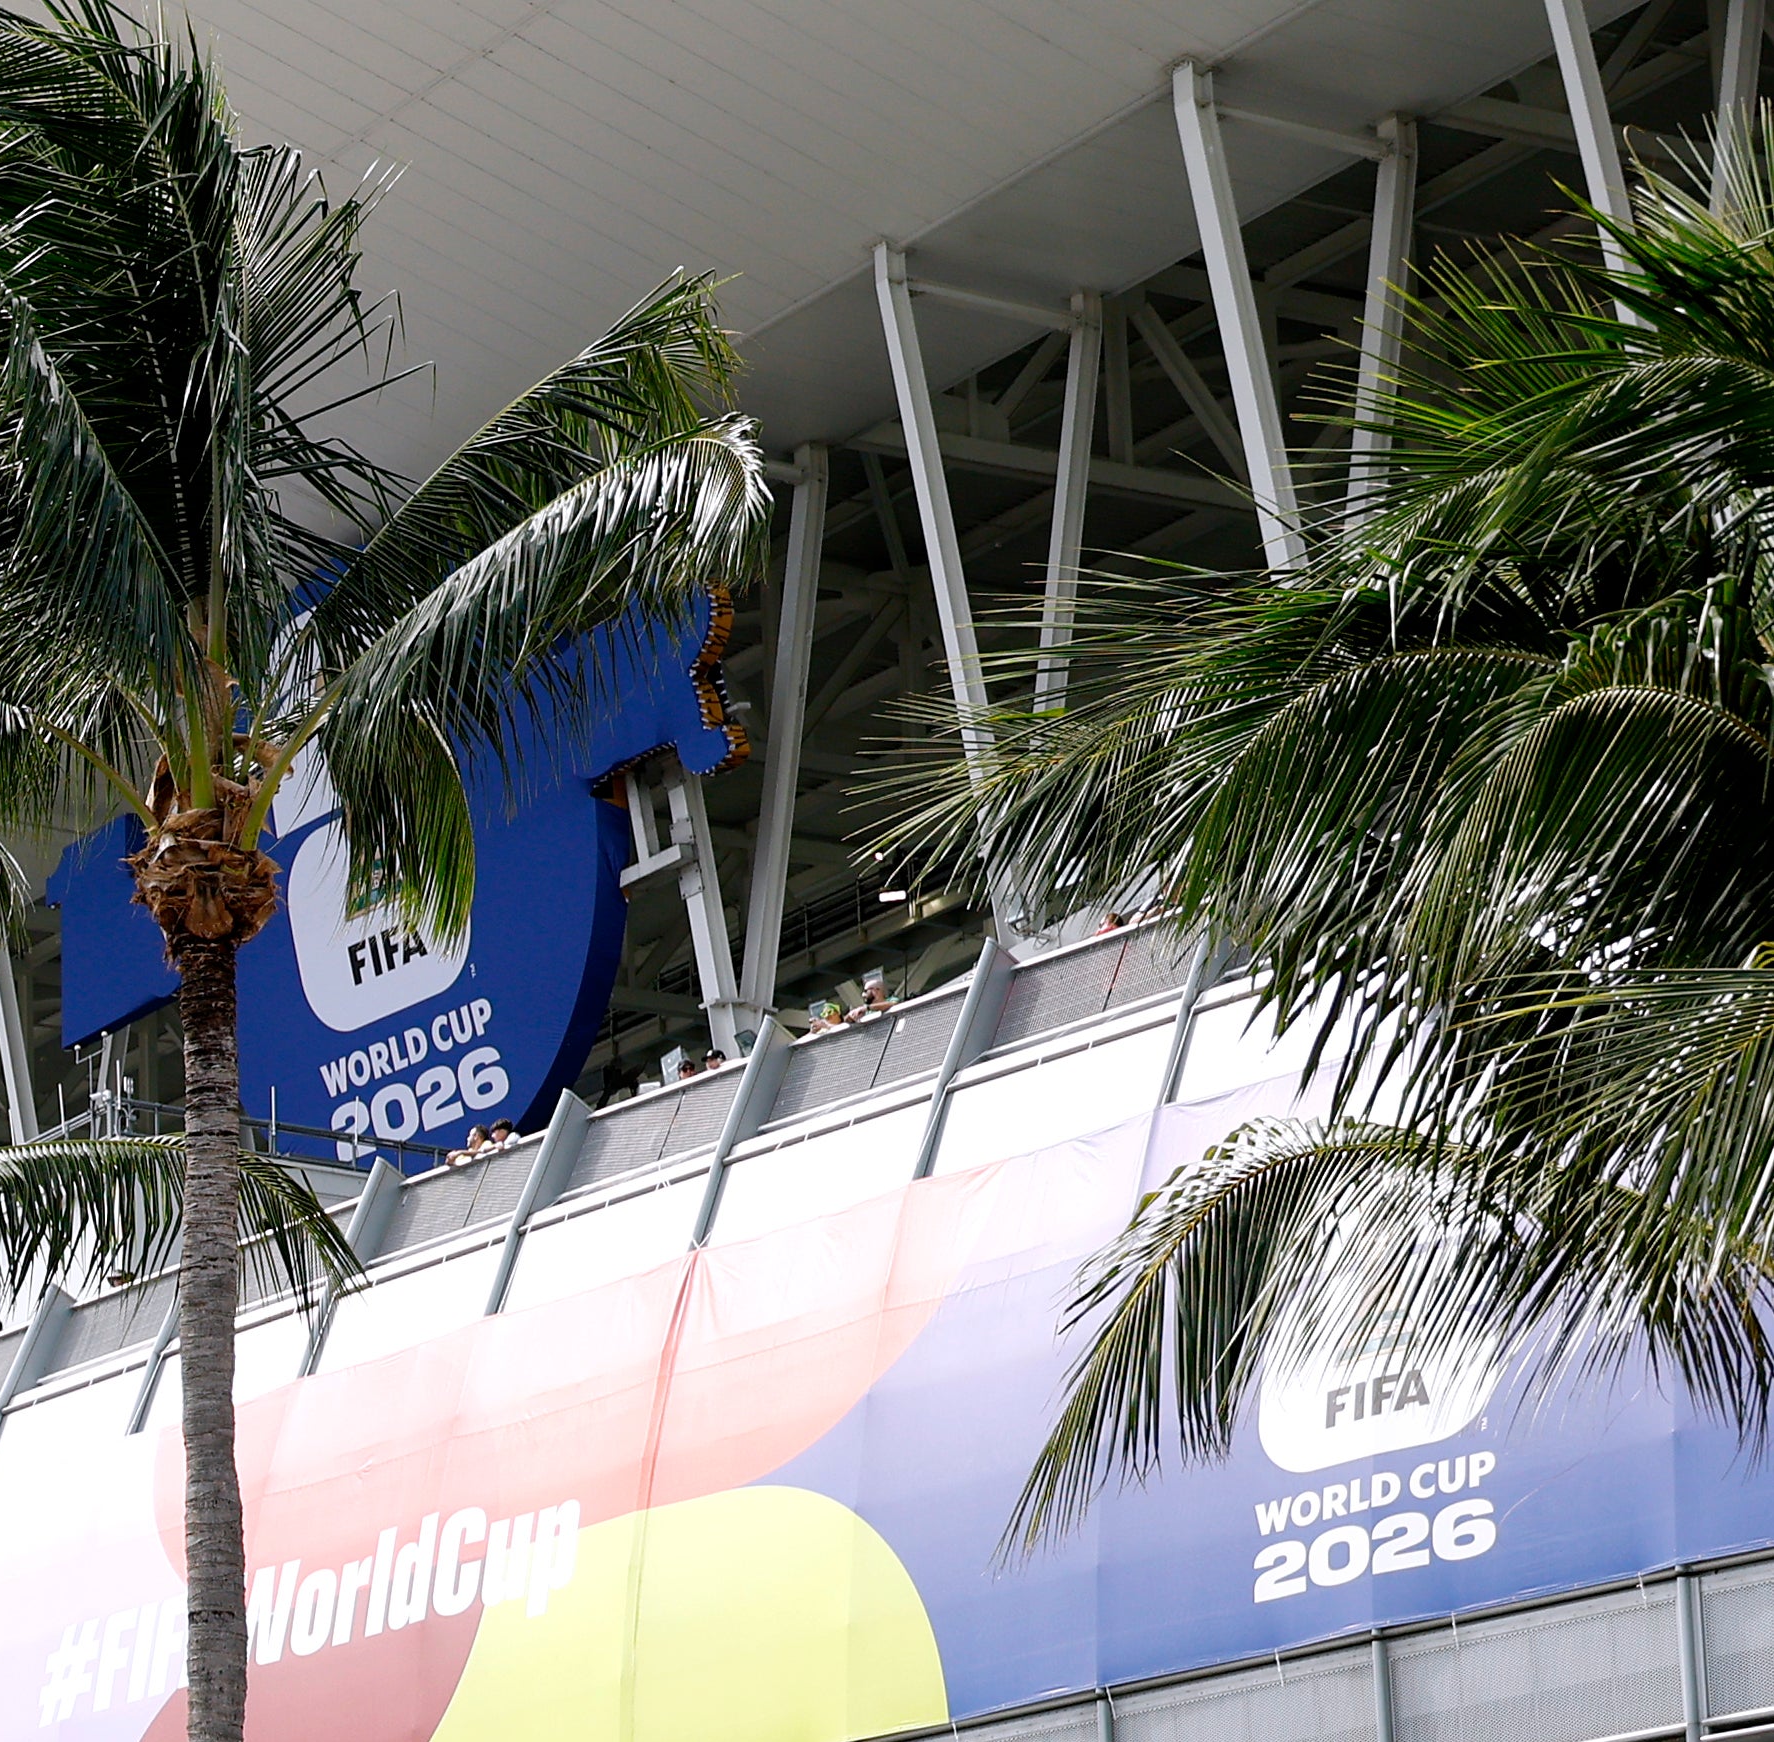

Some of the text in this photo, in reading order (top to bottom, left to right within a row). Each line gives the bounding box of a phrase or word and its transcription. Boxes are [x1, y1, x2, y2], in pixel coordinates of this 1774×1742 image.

[348, 926, 428, 986] FIFA
[319, 998, 492, 1098] WORLD CUP
[330, 1046, 510, 1163] 2026
[1325, 1369, 1430, 1429] FIFA
[1254, 1451, 1496, 1536] WORLD CUP
[1253, 1498, 1497, 1603] 2026
[38, 1499, 581, 1728] #FIFWorldCup
